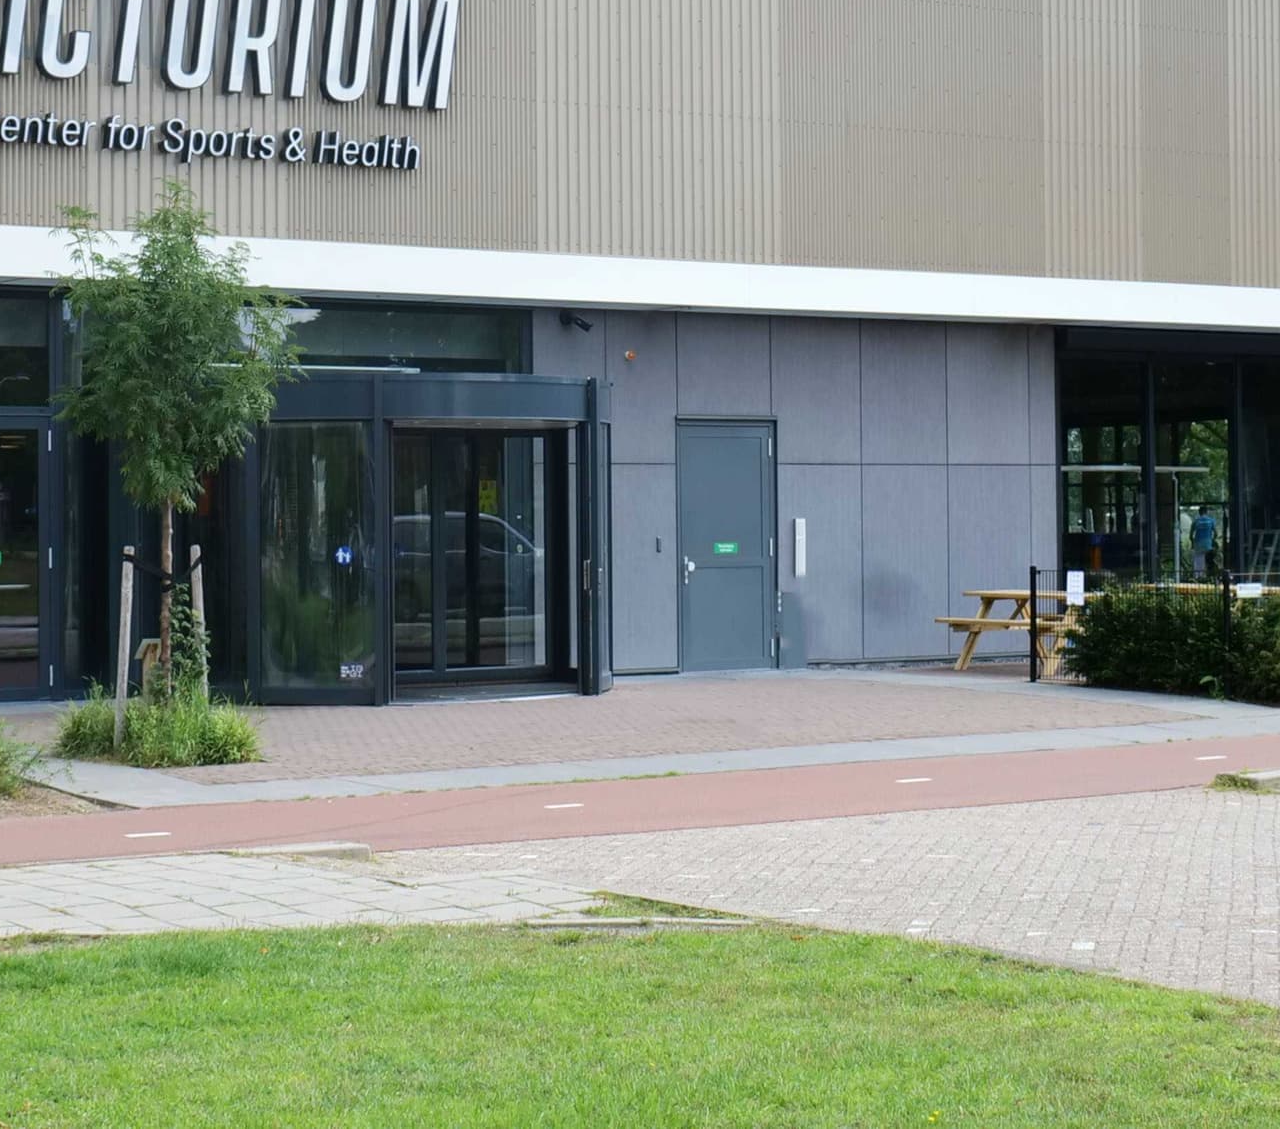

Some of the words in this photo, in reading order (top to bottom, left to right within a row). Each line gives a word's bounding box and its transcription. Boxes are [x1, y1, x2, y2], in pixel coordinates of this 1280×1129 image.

[105, 115, 156, 151] for
[162, 118, 275, 164] Sports
[283, 127, 307, 163] &
[317, 129, 421, 170] Health
